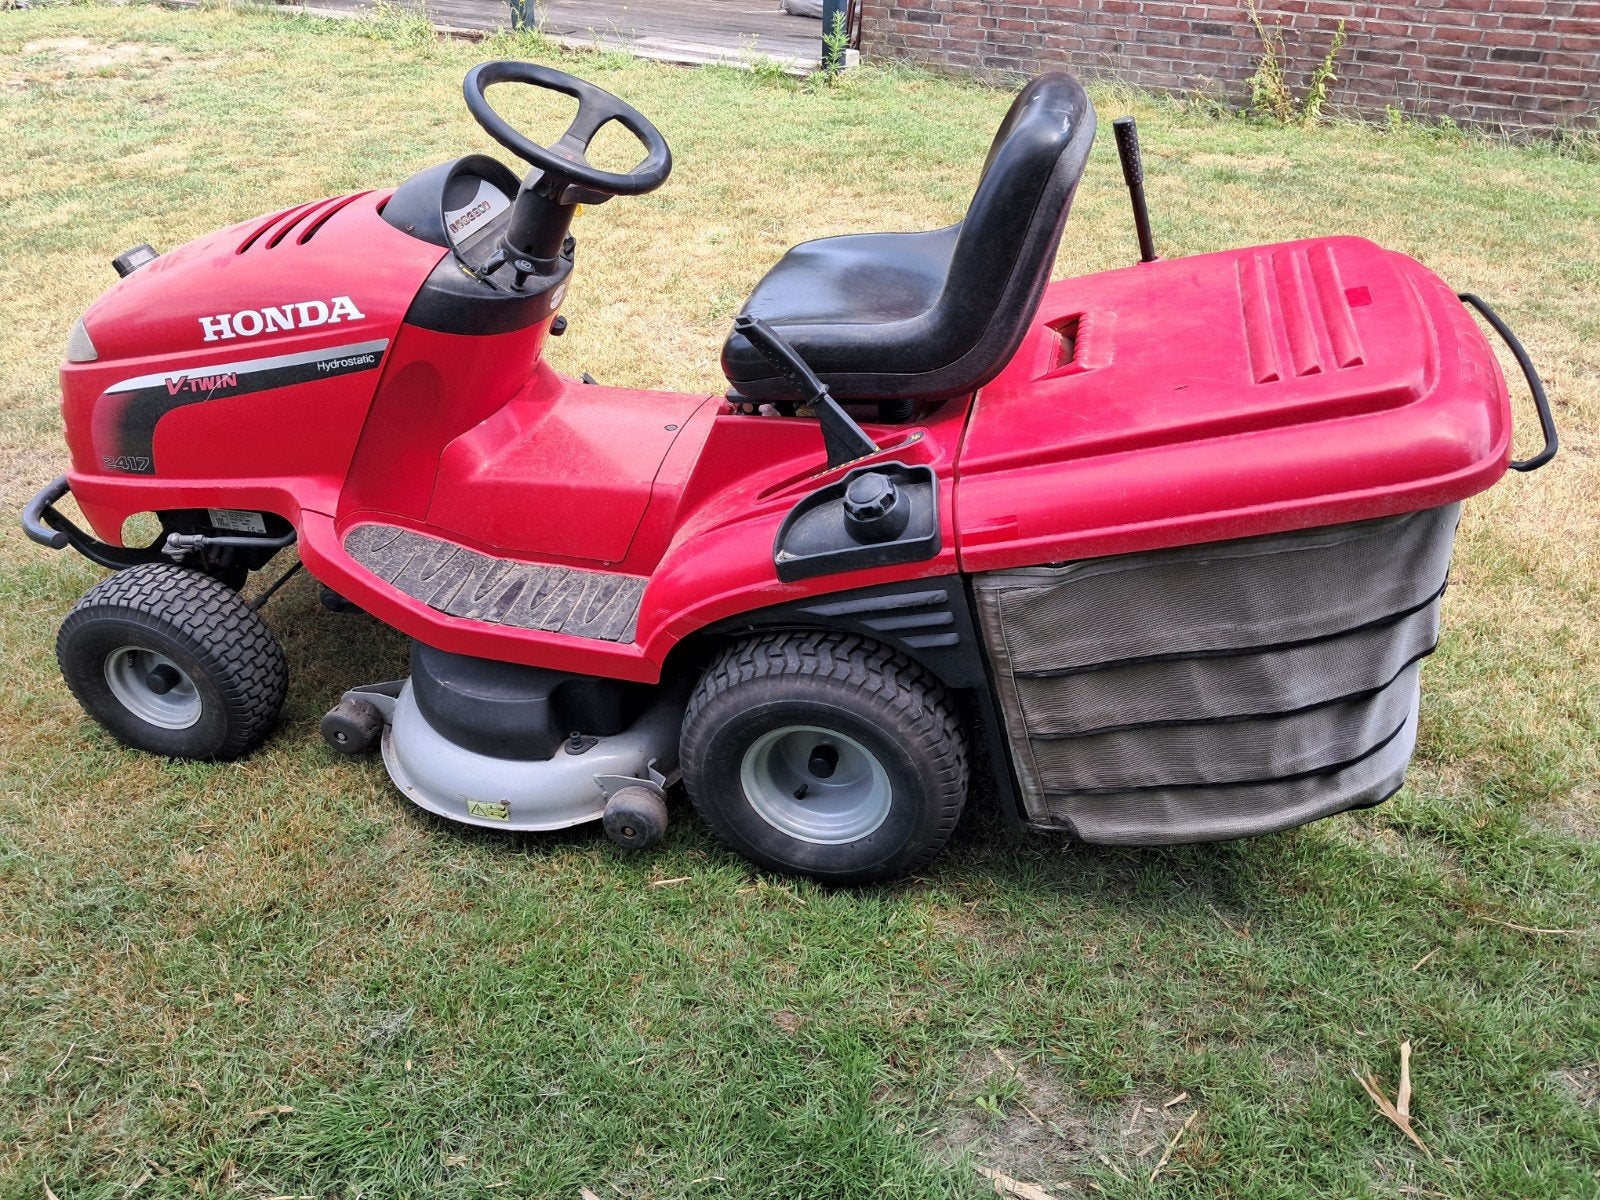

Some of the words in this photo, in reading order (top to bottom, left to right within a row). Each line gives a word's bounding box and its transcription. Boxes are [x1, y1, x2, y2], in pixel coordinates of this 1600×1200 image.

[198, 296, 365, 342] HONDA
[316, 353, 376, 372] Hydrostatic
[165, 372, 238, 396] V-TWIN
[103, 455, 149, 471] 2417
